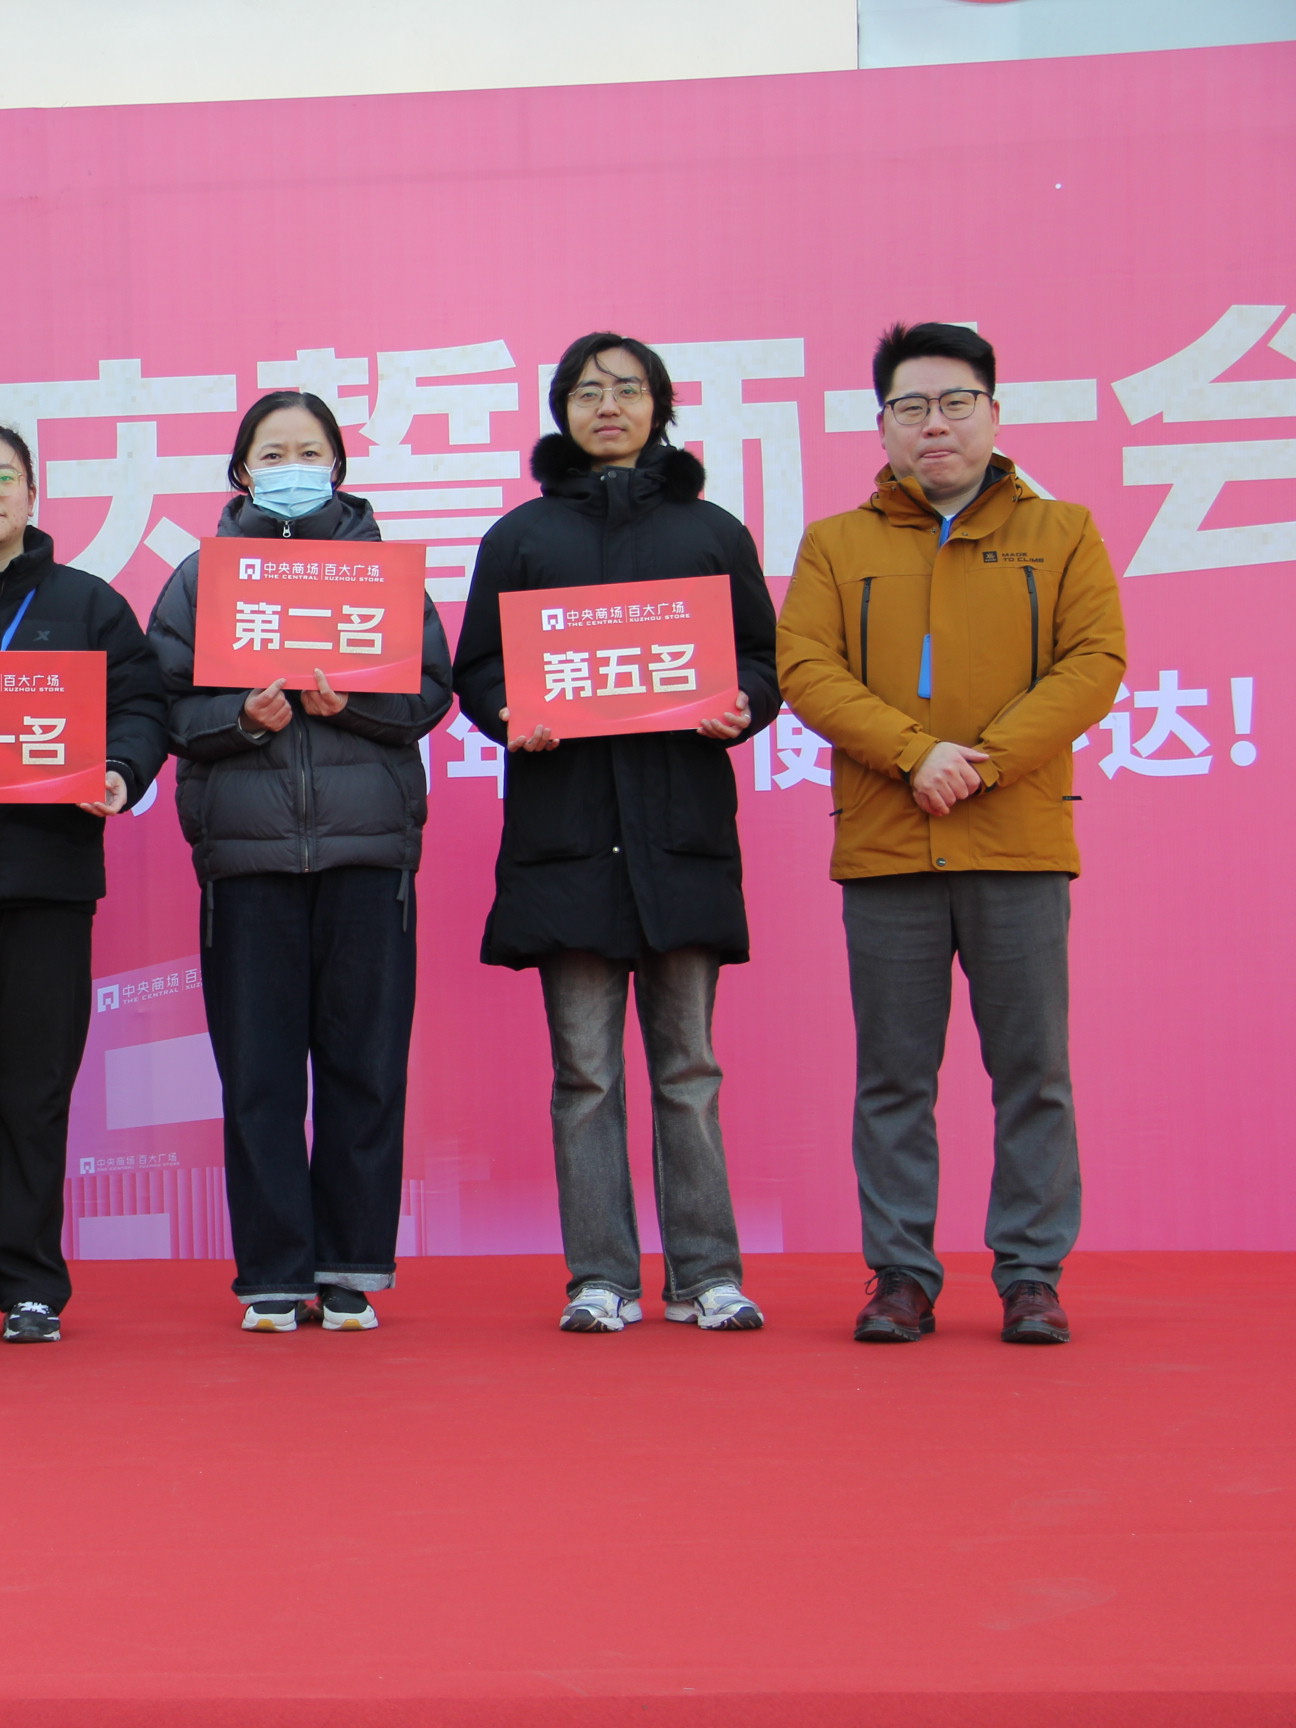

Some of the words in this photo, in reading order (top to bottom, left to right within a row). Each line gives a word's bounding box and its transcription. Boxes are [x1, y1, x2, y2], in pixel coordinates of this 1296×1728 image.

[264, 562, 318, 575] 中央商场
[325, 563, 379, 577] 百大广场
[566, 606, 622, 622] 中央商场
[628, 601, 685, 618] 百大广场
[232, 601, 385, 655] 第二名
[4, 674, 60, 687] 百大广场
[543, 643, 697, 702] 第五名
[122, 973, 179, 998] 中央商场
[123, 997, 139, 1005] THE
[141, 988, 179, 1001] CENTRAL
